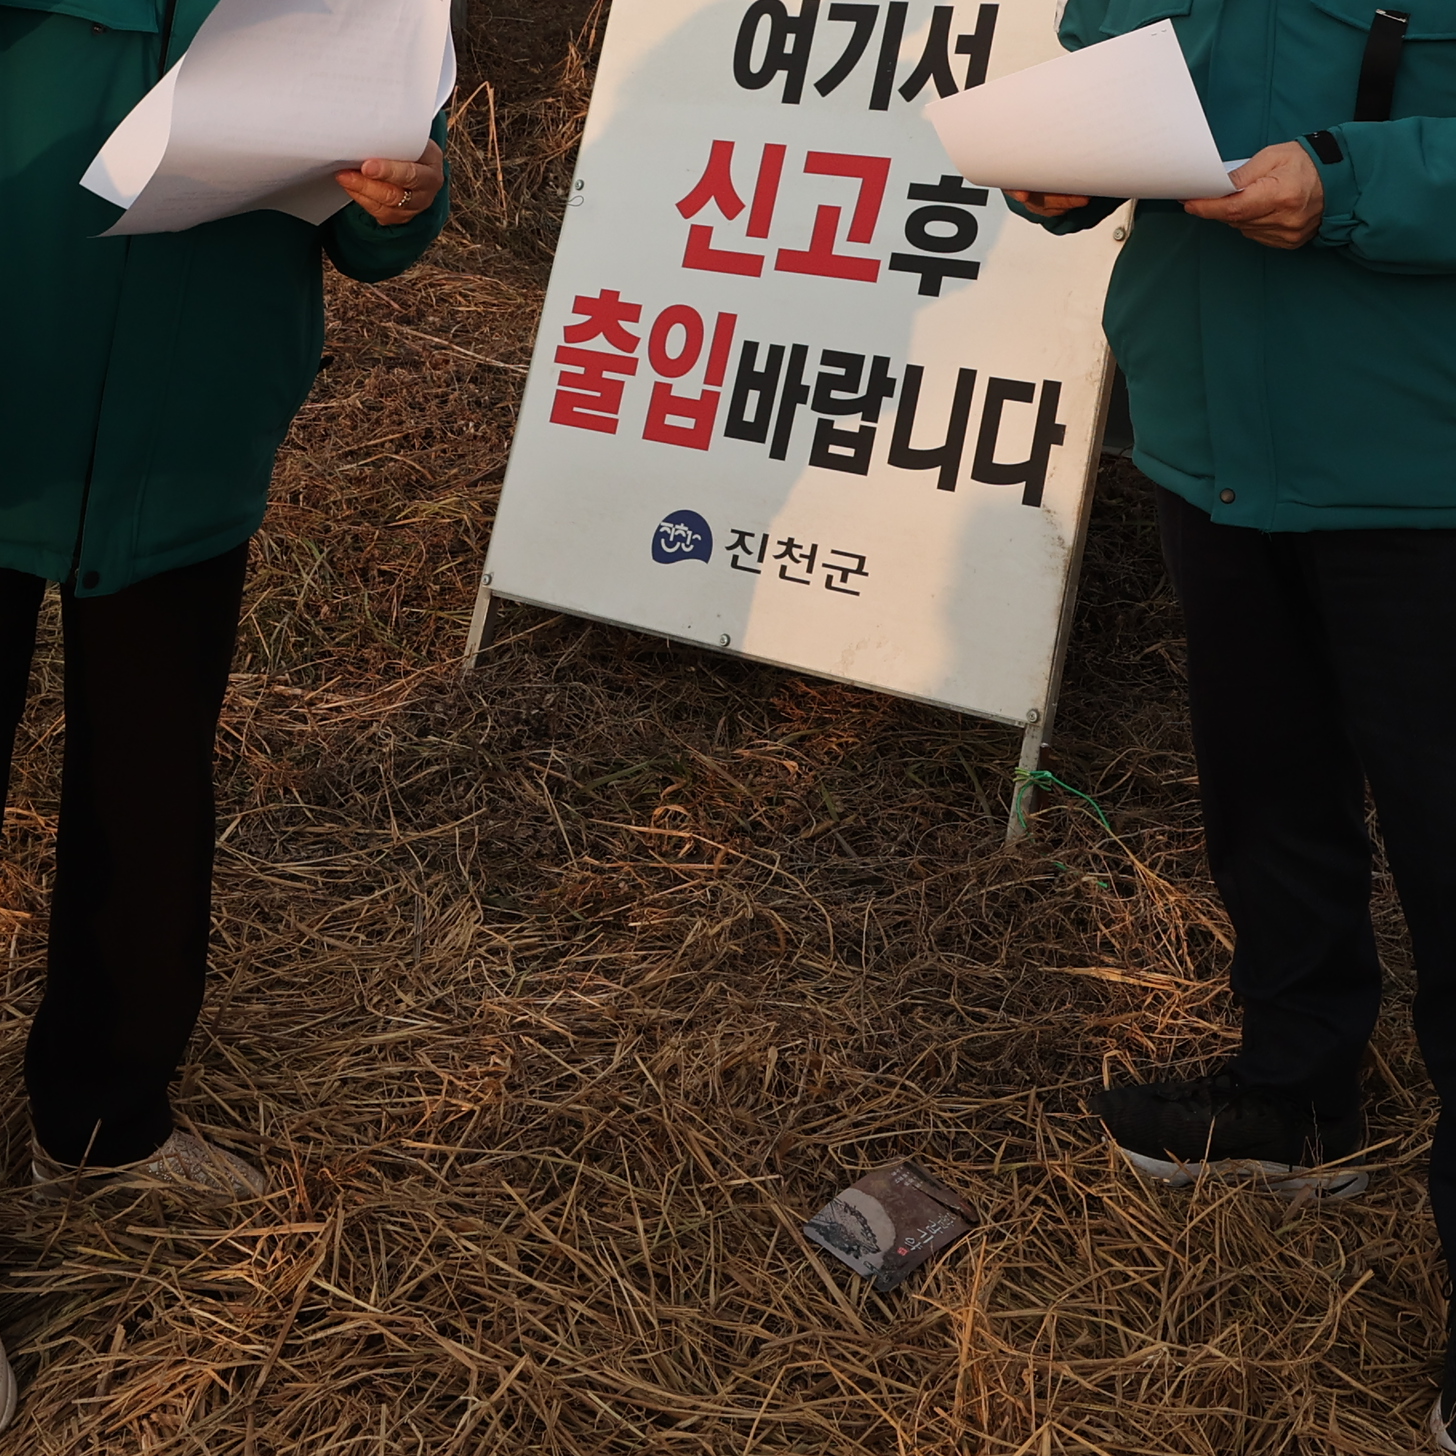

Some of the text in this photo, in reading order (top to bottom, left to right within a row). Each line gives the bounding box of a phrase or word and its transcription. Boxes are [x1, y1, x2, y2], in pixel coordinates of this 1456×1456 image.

[675, 139, 989, 299] 신고후
[549, 288, 1067, 508] 출입바랍니다
[724, 528, 870, 597] 진천군
